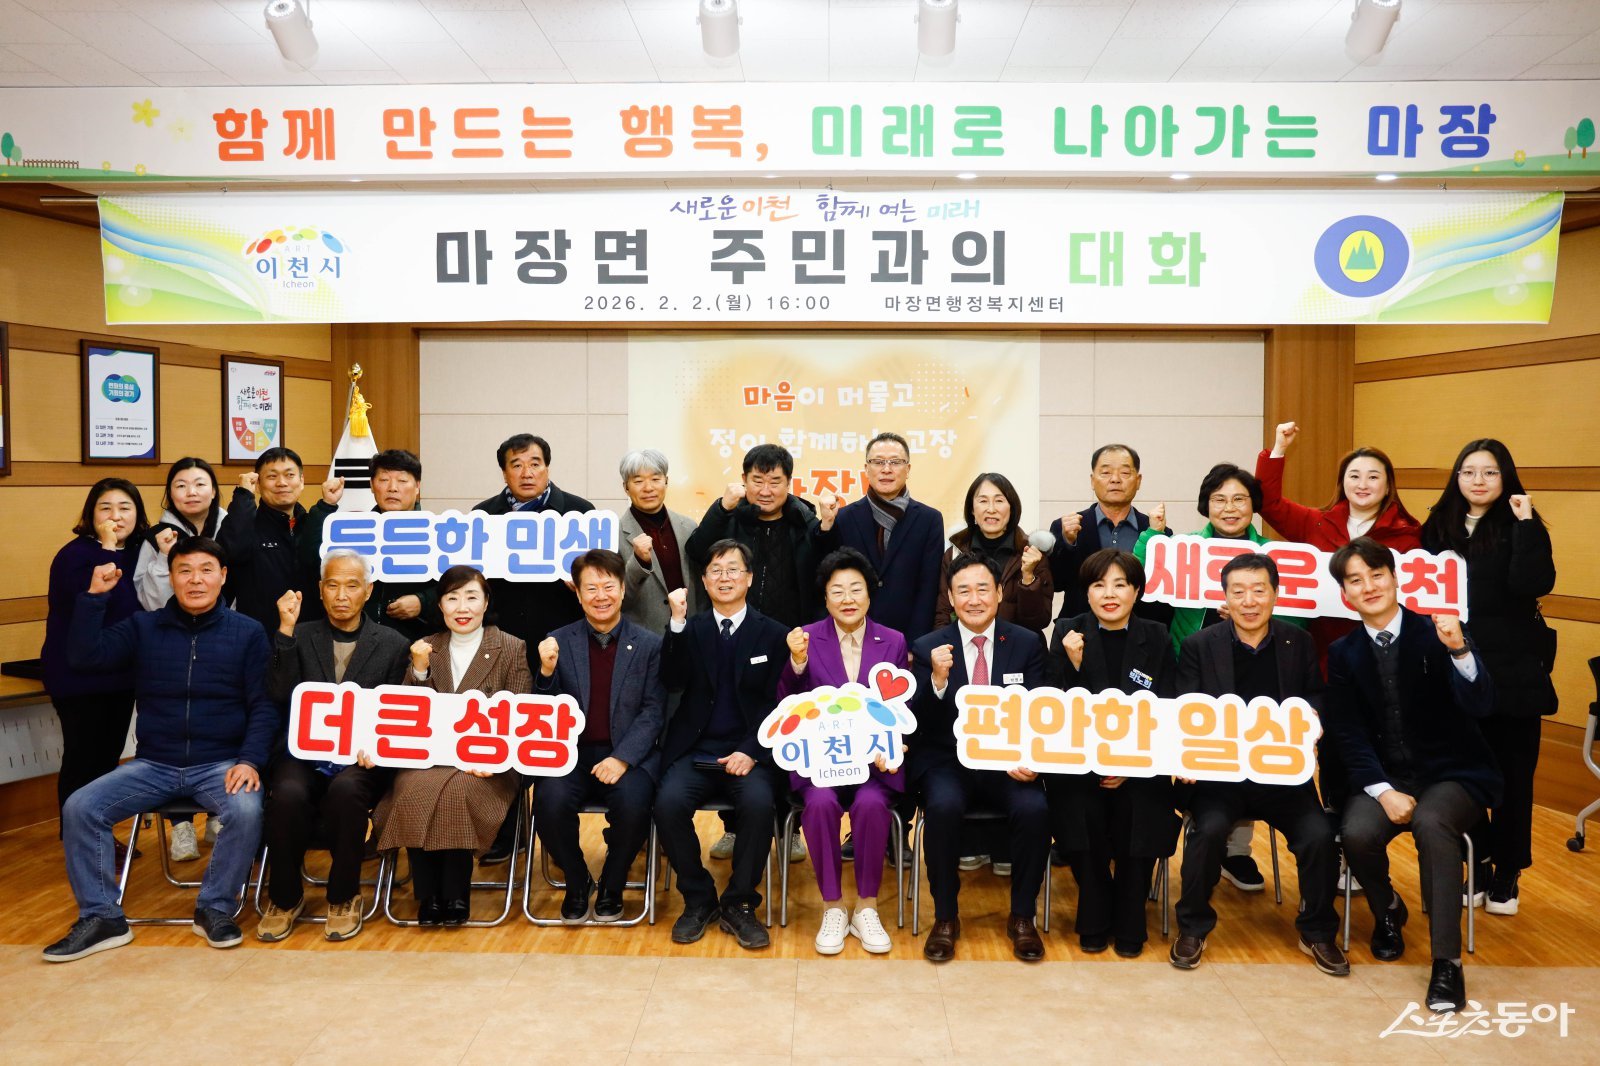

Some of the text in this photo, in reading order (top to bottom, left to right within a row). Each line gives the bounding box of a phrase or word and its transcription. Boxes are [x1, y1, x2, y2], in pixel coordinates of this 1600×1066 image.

[212, 103, 1497, 162] 함께 만드는 행복, 미래로 나아가는 마장
[670, 194, 981, 223] 새로운 이천 함께 여는 미래
[256, 256, 341, 280] 이천시
[436, 229, 1207, 287] 마장면 주민과의 대화
[282, 280, 315, 289] Icheon
[584, 294, 1065, 313] 2026. 2. 2.(월) 16:00 마장면행정복지센터
[743, 380, 915, 413] 마음이 머물고
[778, 428, 879, 458] 함께하
[906, 429, 958, 458] 고장
[326, 517, 612, 575] 든든한 민생
[1341, 556, 1460, 616] 천
[297, 690, 577, 768] 더 큰 성장
[962, 693, 1311, 775] 편안한 일상
[781, 730, 895, 769] 이천시
[819, 767, 861, 779] Icheon
